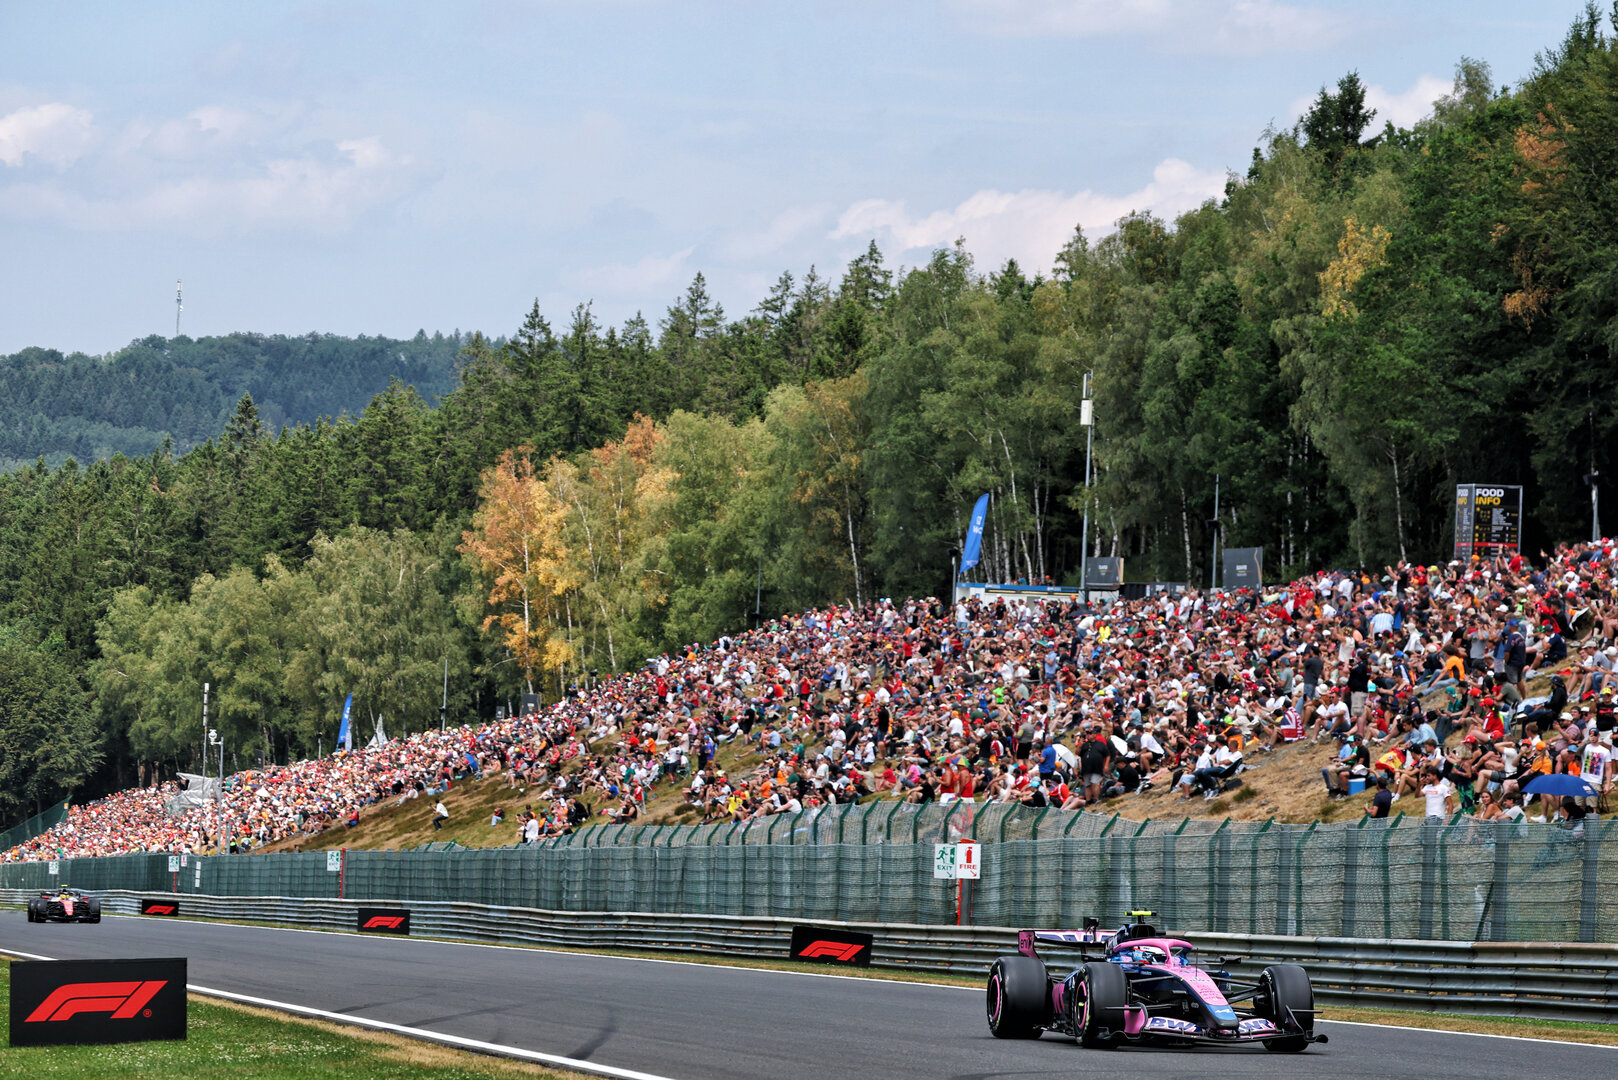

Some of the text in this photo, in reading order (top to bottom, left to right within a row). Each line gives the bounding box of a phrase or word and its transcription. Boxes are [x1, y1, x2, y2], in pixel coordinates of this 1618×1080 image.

[1475, 488, 1505, 498] FOOD
[1475, 497, 1501, 506] INFO
[144, 905, 176, 915] F1
[362, 916, 406, 929] F1
[797, 940, 865, 961] F1
[24, 980, 169, 1023] F1
[1149, 1017, 1204, 1033] BWT
